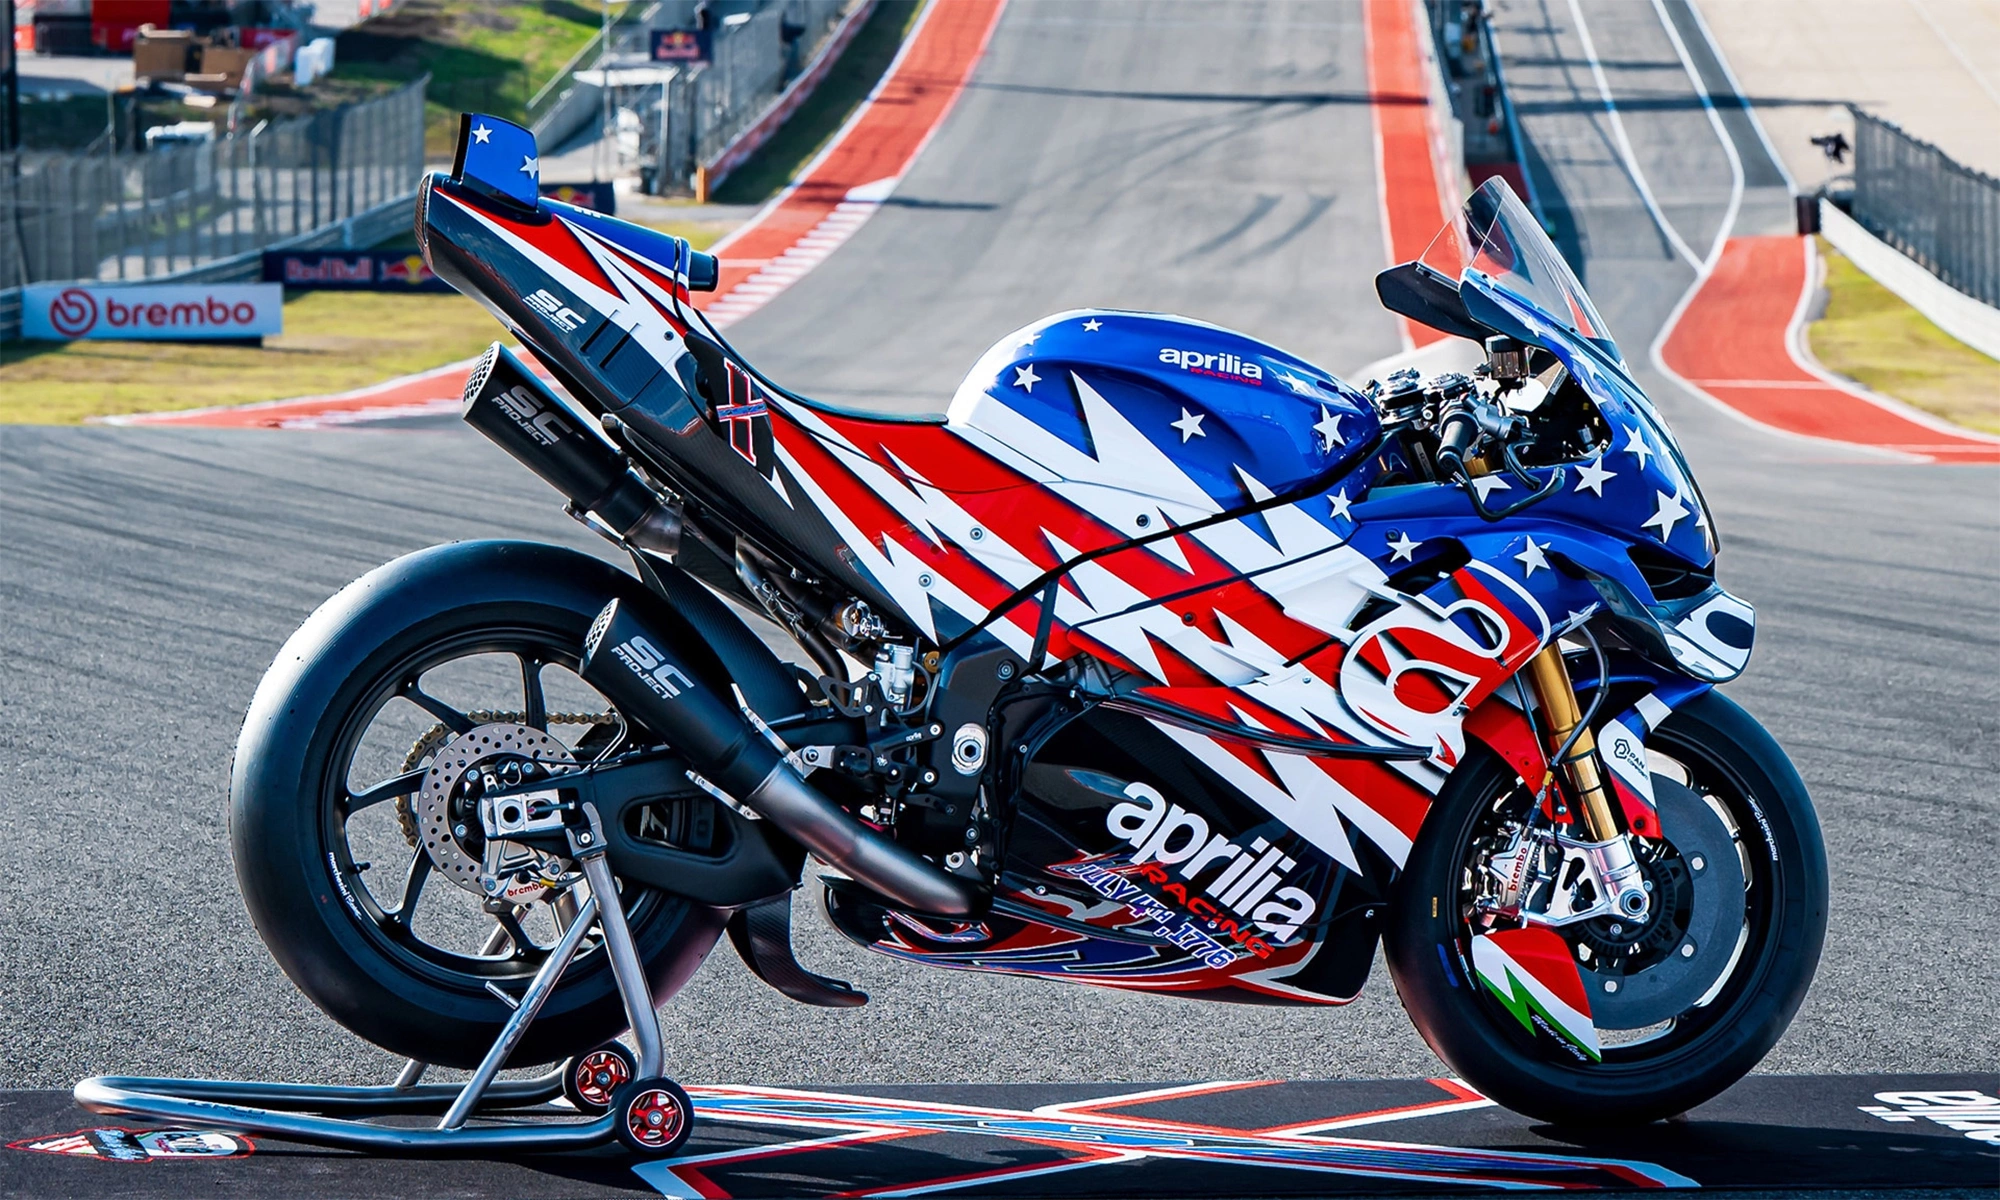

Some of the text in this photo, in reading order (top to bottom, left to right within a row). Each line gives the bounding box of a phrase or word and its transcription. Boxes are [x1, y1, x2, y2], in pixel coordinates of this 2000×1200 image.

[107, 297, 255, 326] brembo
[1158, 348, 1263, 380] aprilia
[1190, 367, 1263, 387] RACING
[491, 396, 552, 446] PROJECT
[500, 385, 573, 443] SC
[610, 646, 673, 699] PROJECT
[620, 635, 695, 697] SC
[1629, 752, 1645, 769] PAN
[1106, 781, 1316, 943] aprilia
[1507, 847, 1527, 891] brembo
[507, 883, 545, 897] brembo
[1141, 864, 1275, 960] RACING
[1070, 864, 1142, 900] JULY
[1167, 922, 1237, 969] 1776
